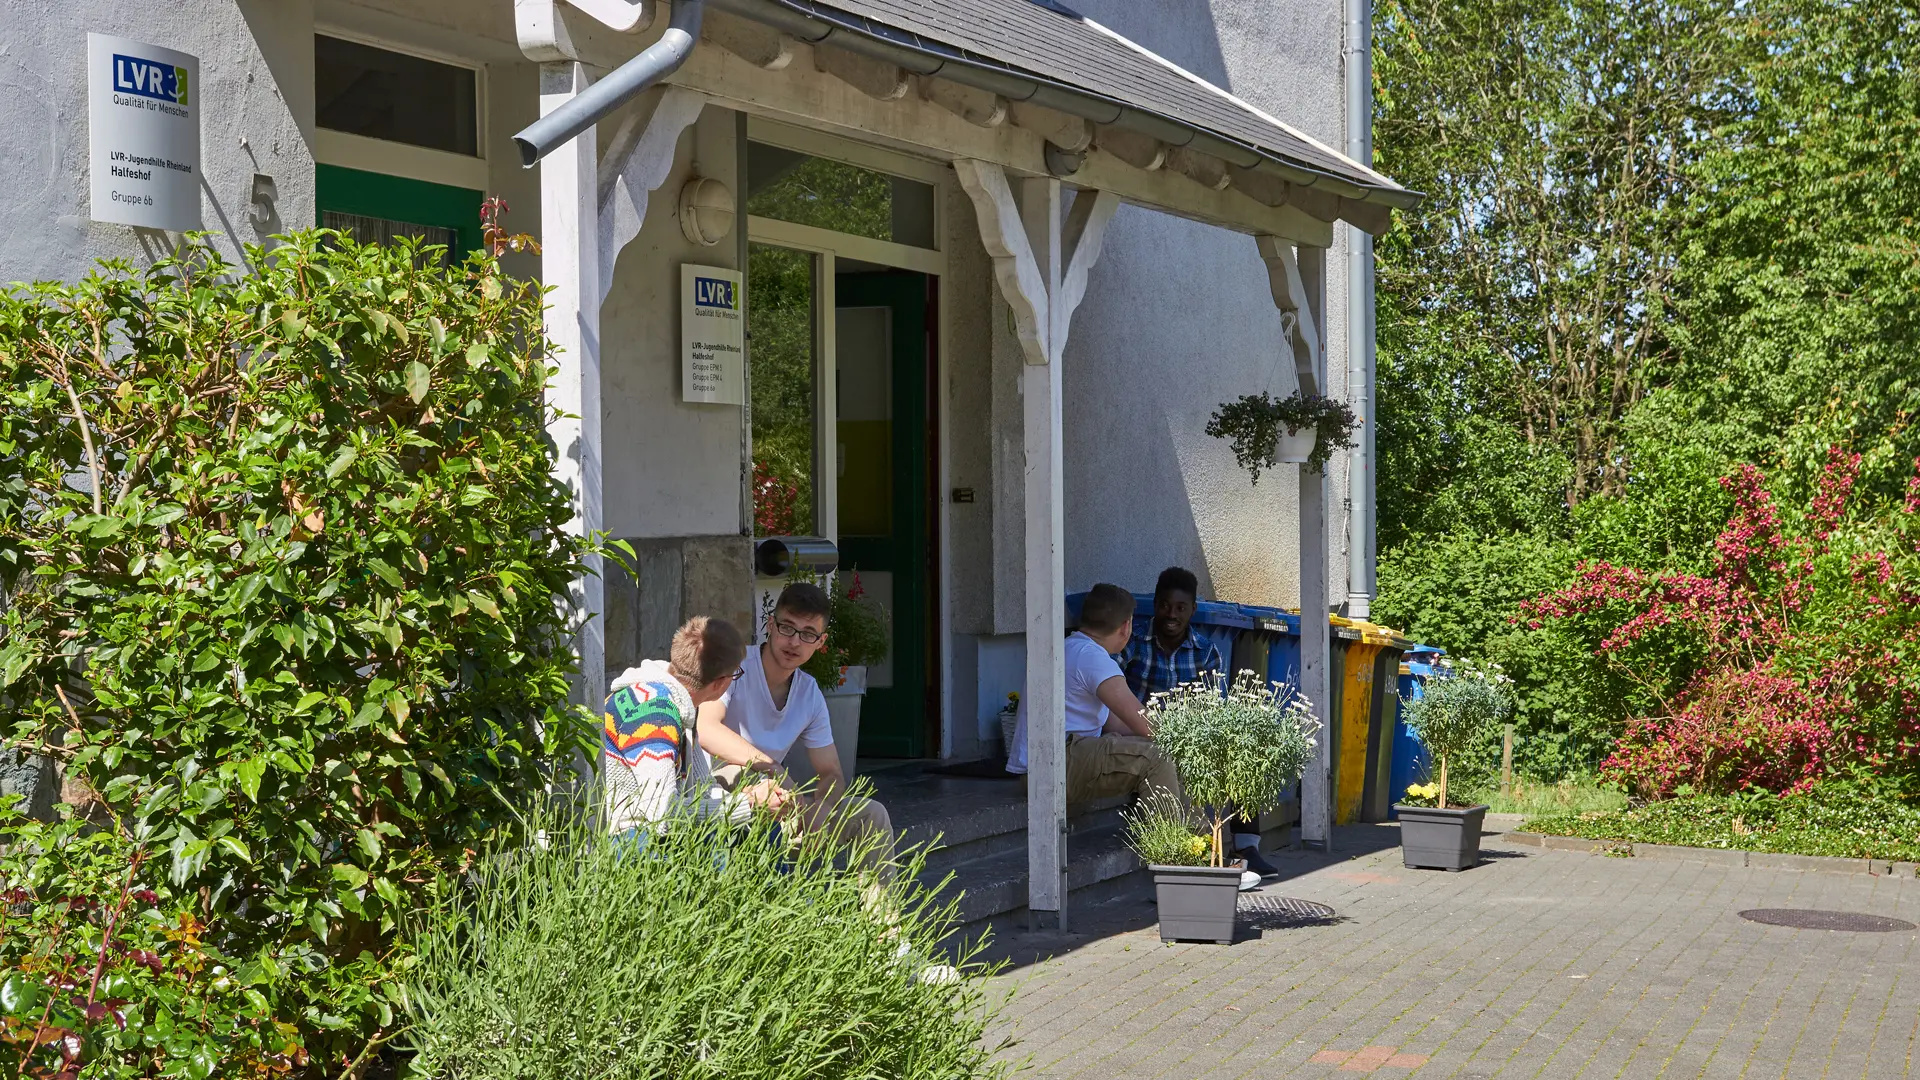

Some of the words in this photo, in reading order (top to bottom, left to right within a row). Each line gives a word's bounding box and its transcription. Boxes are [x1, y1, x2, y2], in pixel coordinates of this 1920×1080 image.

[117, 59, 164, 95] LVR
[113, 94, 145, 109] Qualität
[146, 100, 157, 112] für
[158, 103, 189, 119] Menschen
[110, 151, 166, 168] LVR-Jugendhilfe
[166, 160, 192, 174] Rheinland
[111, 166, 151, 181] Halfeshof
[111, 190, 142, 206] Gruppe
[143, 192, 153, 206] 6b
[250, 173, 278, 233] 5
[697, 281, 726, 305] LVR
[695, 307, 715, 318] Qualität
[692, 341, 727, 352] LVR-Jugendhilfe
[692, 352, 715, 361] Halfeshof
[692, 362, 710, 372] Gruppe
[692, 372, 710, 382] Gruppe
[692, 383, 710, 392] Gruppe
